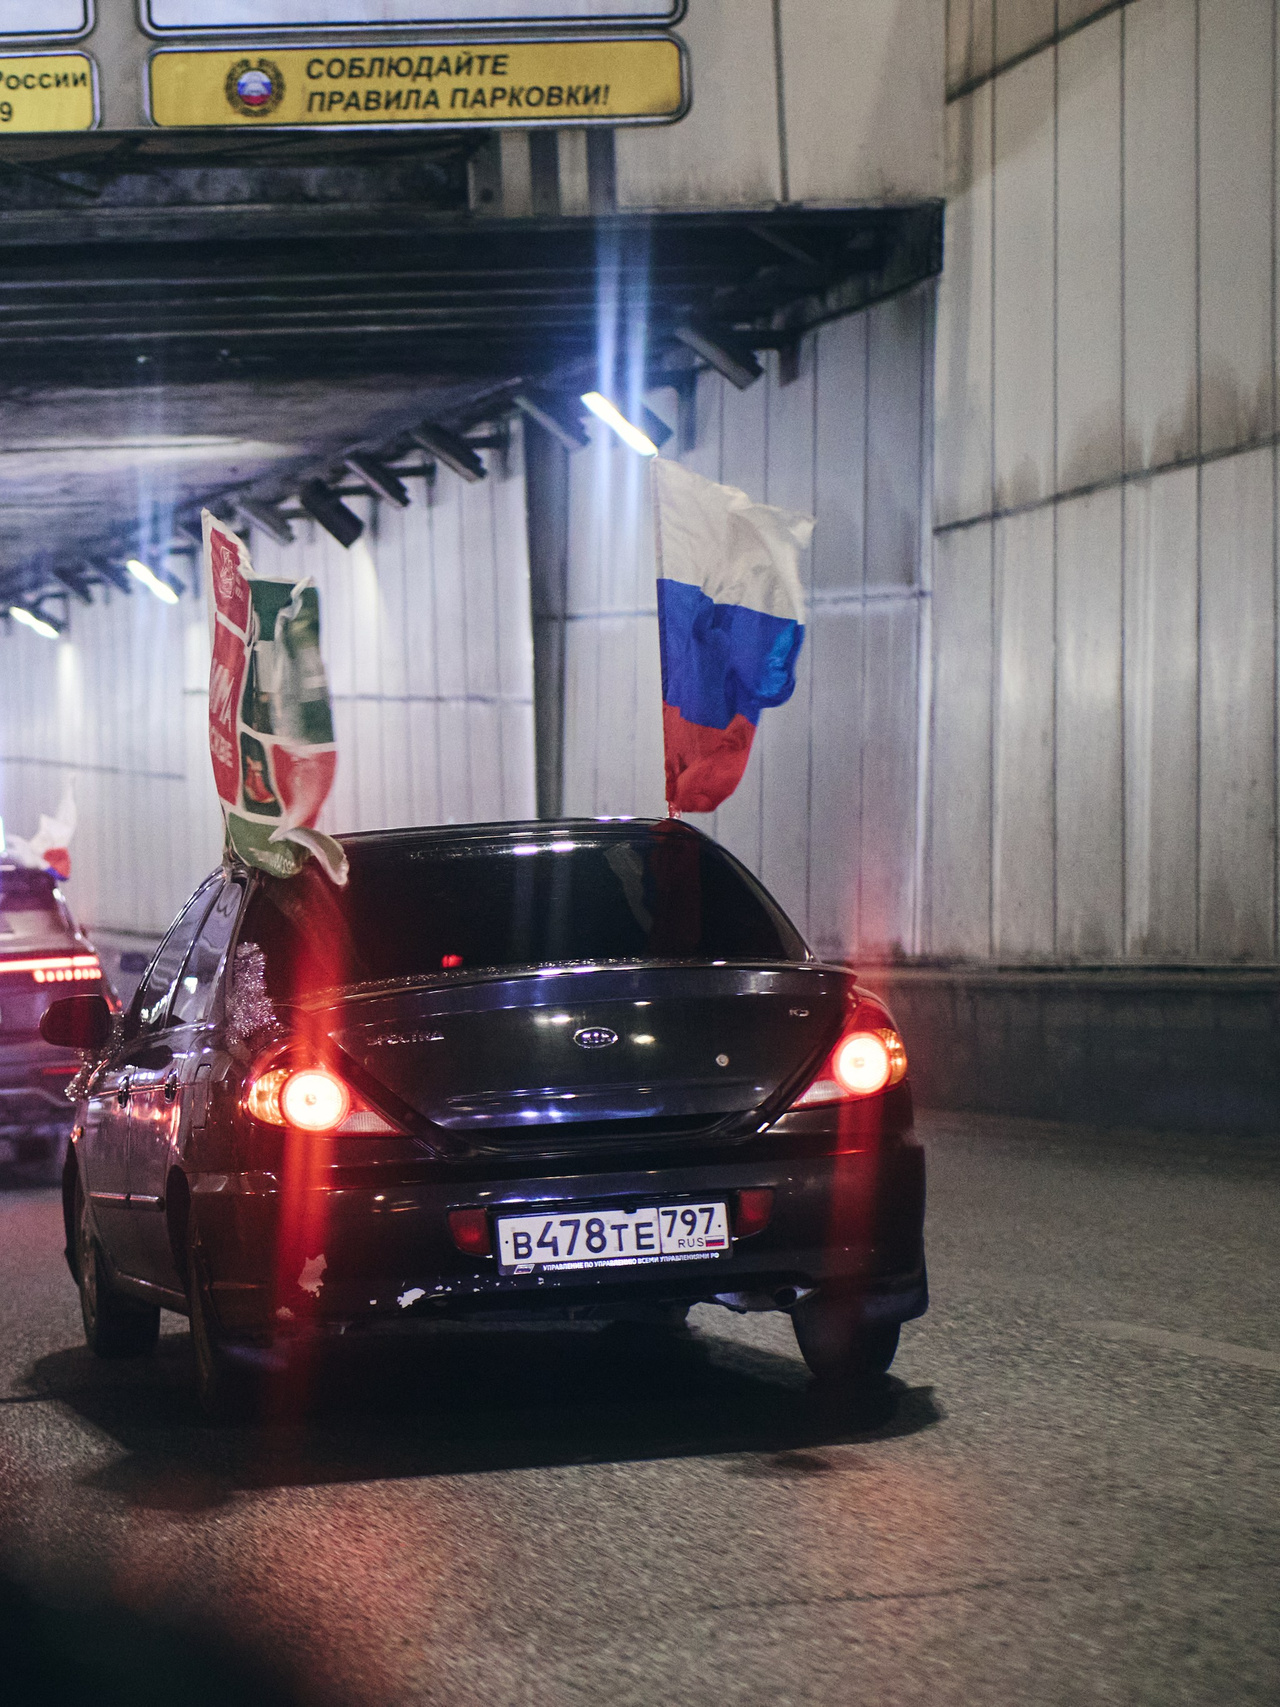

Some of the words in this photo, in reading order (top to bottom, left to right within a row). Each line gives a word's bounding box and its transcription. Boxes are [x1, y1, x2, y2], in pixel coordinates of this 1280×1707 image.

[305, 52, 511, 82] СОБЛЮДАЙТЕ
[305, 89, 440, 112] ПРАВИЛА
[450, 84, 611, 109] ПАРКОВКИ!
[661, 1207, 715, 1237] 797
[512, 1217, 656, 1261] В478ТЕ
[677, 1237, 705, 1248] RUS
[543, 1262, 584, 1271] УПРАВЛЕНИЕ
[584, 1261, 593, 1269] ПО
